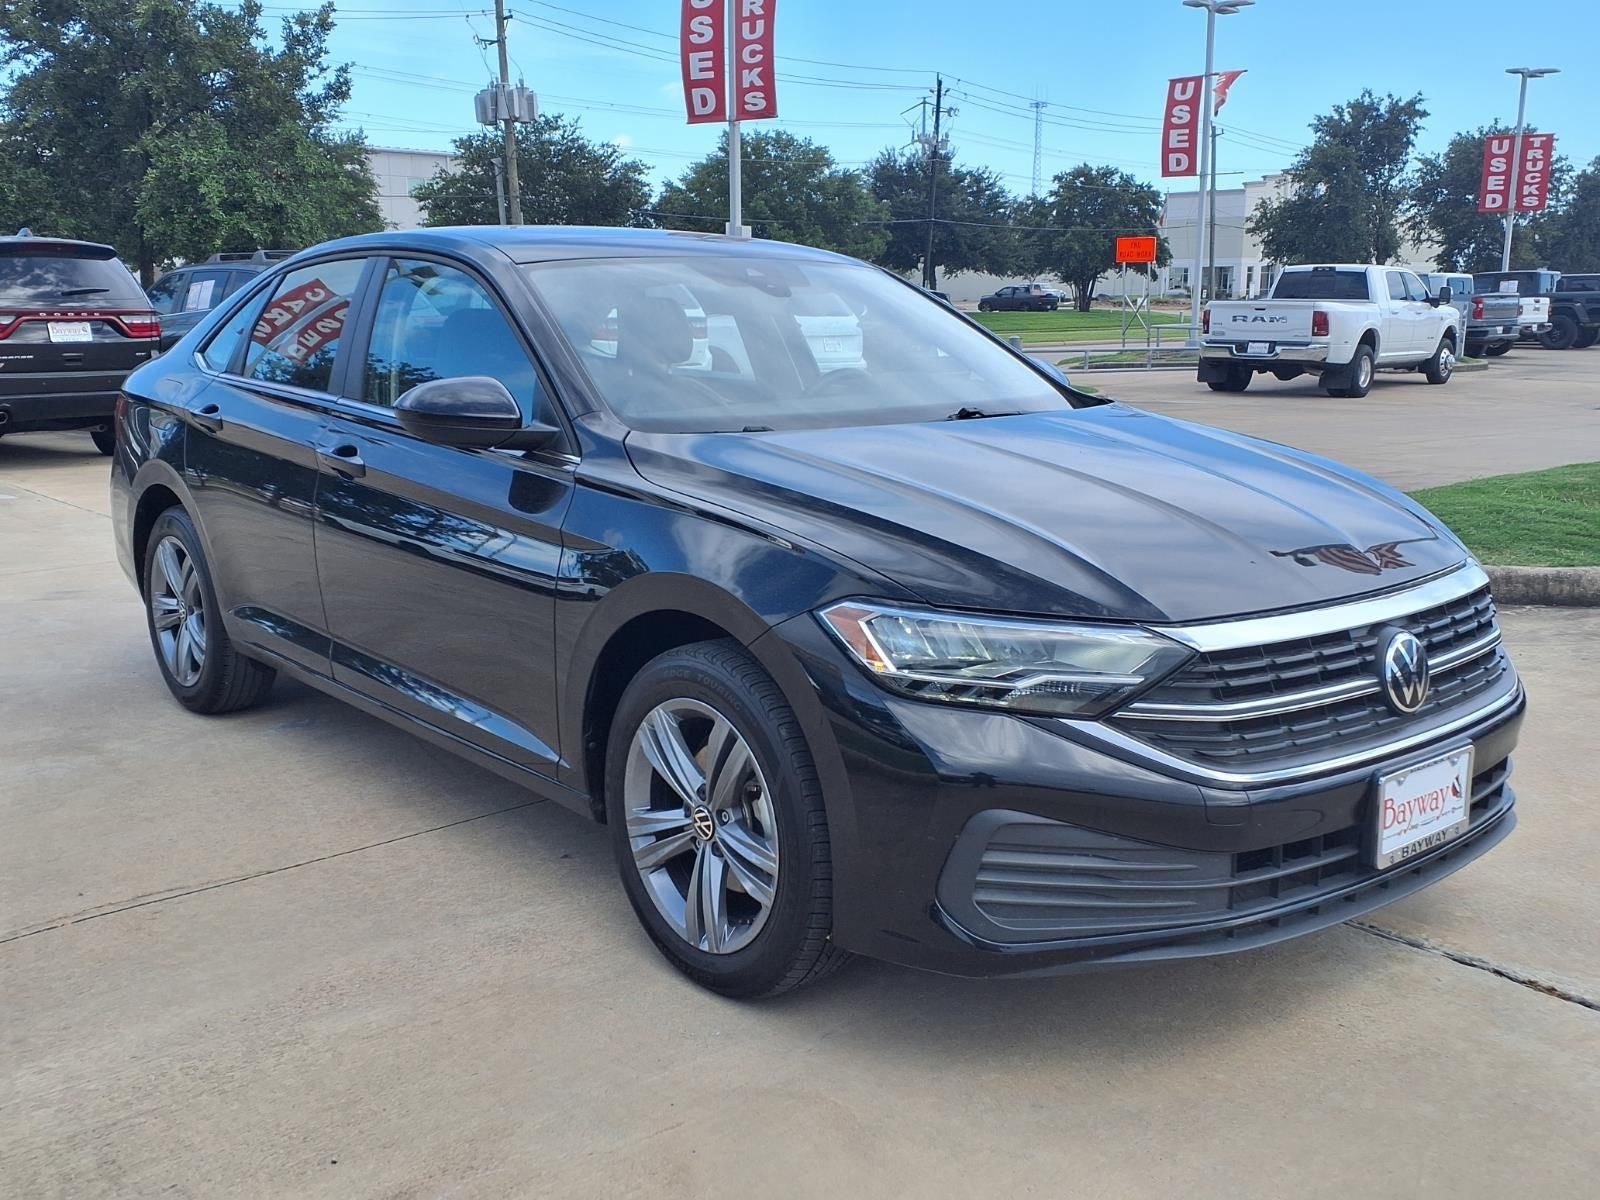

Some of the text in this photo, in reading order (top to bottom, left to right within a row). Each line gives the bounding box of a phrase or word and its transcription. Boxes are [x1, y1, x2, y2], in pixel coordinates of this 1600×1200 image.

[1168, 81, 1195, 172] USED
[1485, 139, 1510, 208] USED
[1522, 136, 1547, 207] TRUCKS
[1232, 315, 1288, 323] RAM
[1383, 786, 1450, 833] Bayway
[1402, 831, 1448, 858] BAYWAY
